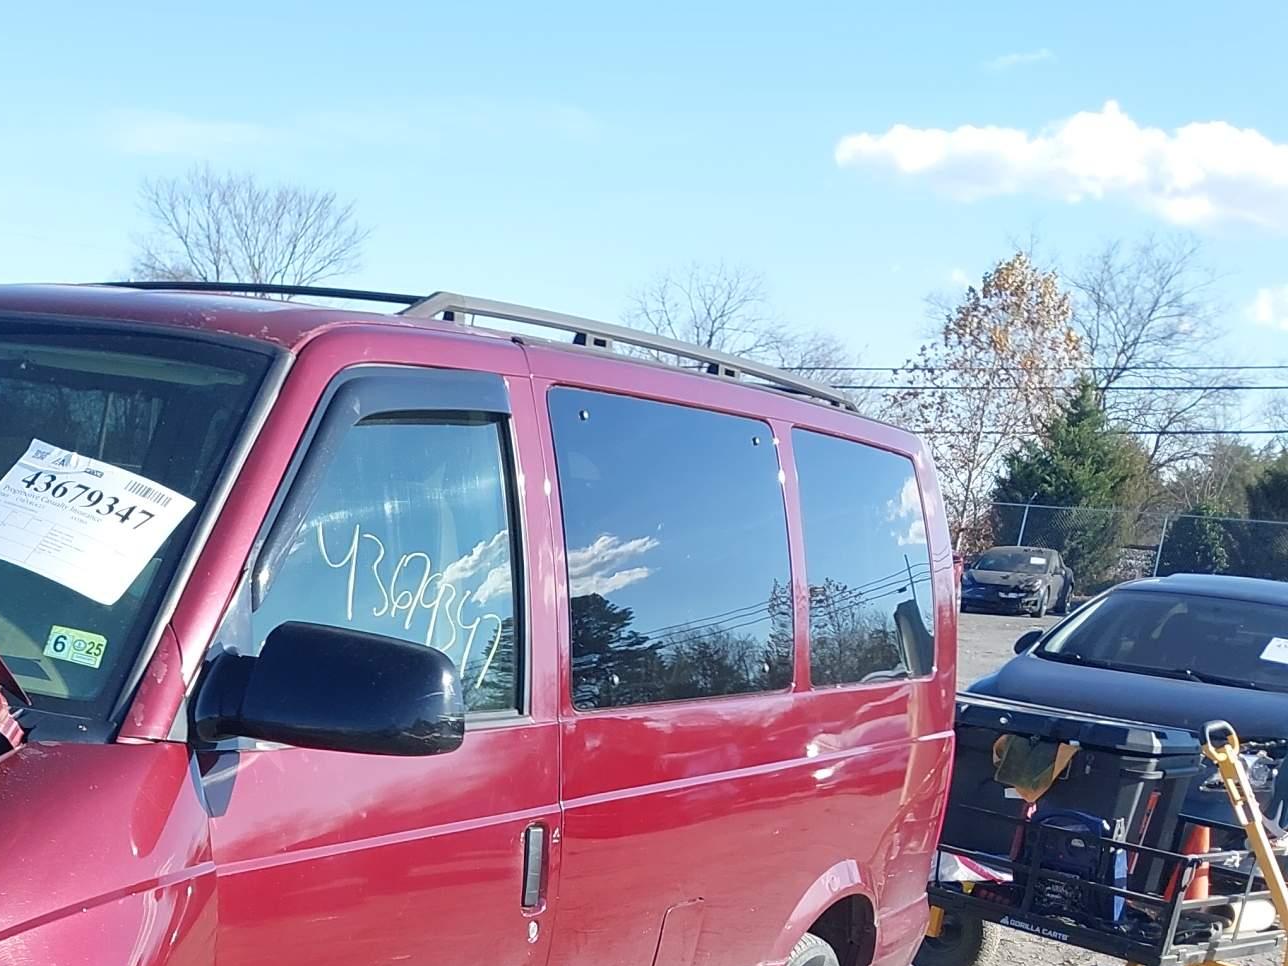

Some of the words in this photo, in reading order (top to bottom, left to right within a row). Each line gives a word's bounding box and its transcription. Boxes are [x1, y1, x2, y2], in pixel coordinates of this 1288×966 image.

[21, 470, 155, 530] 43679347
[317, 521, 502, 689] 43679347
[53, 635, 67, 653] 6
[86, 641, 104, 657] 25
[1009, 918, 1041, 934] GORILLA
